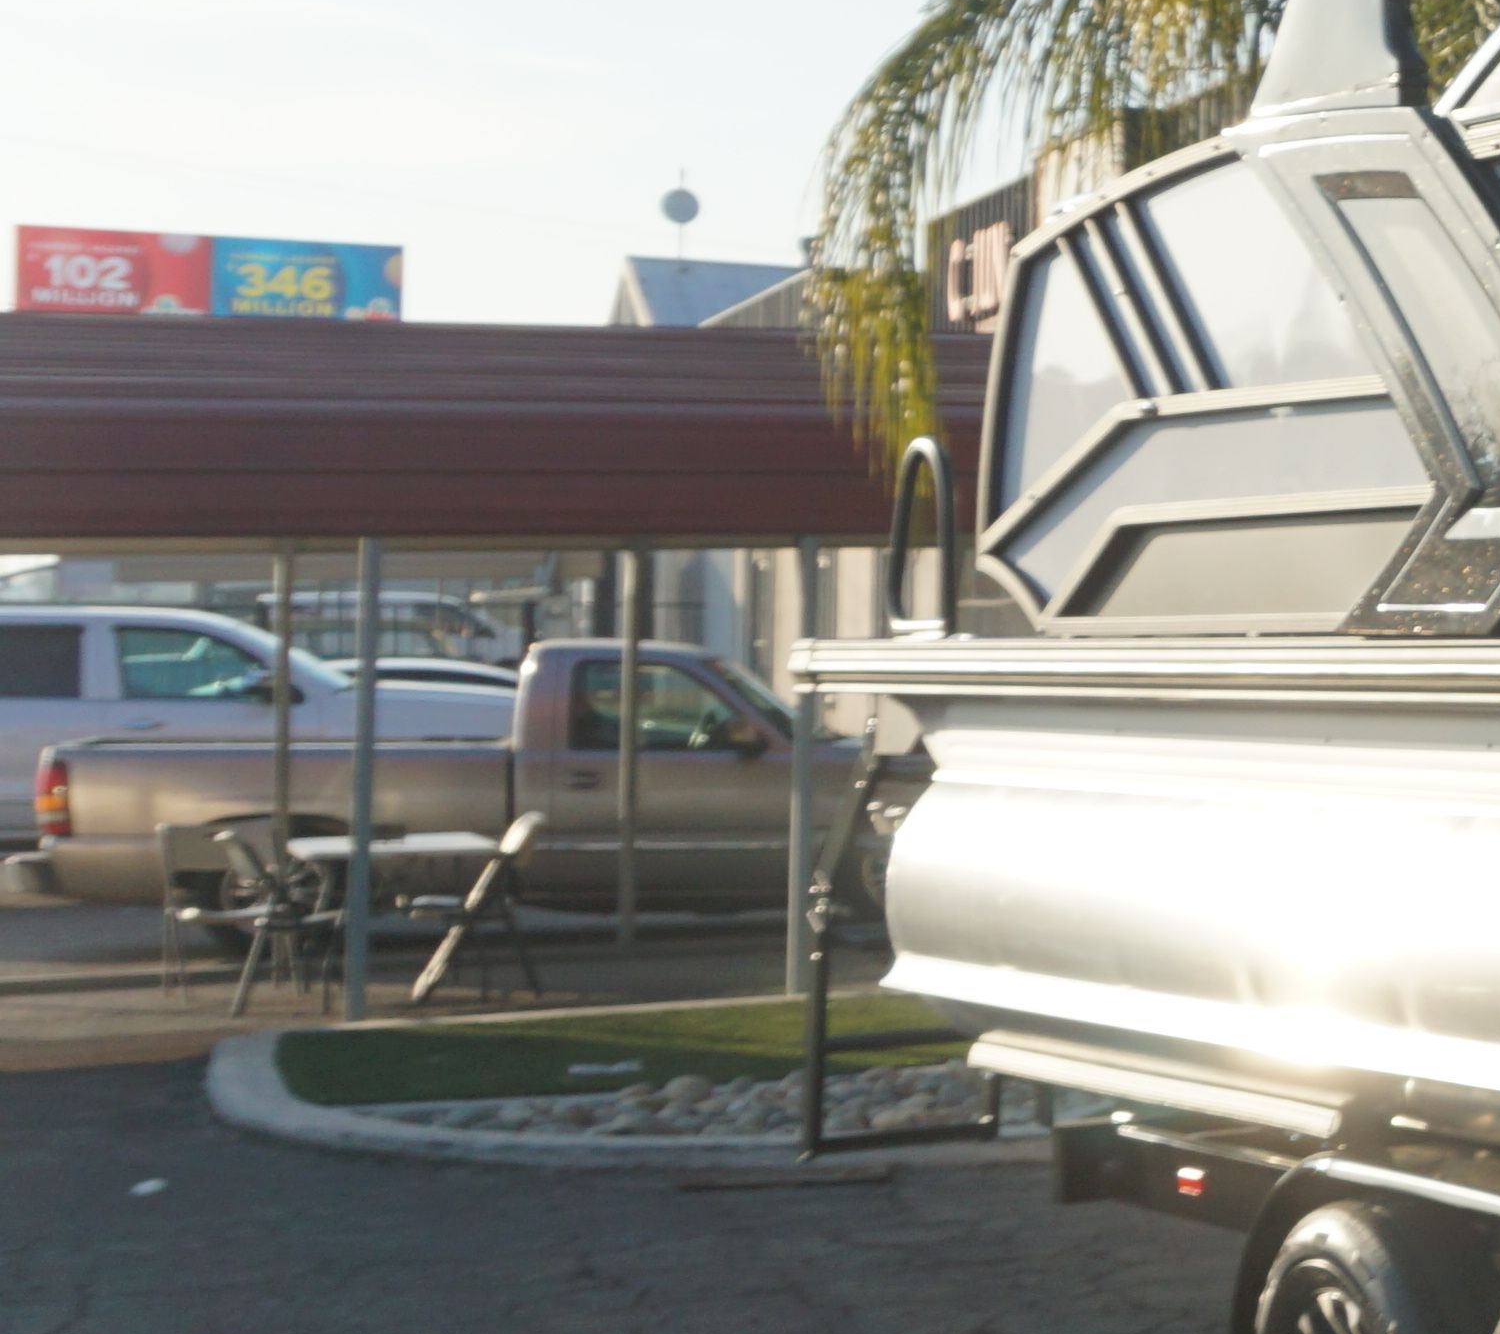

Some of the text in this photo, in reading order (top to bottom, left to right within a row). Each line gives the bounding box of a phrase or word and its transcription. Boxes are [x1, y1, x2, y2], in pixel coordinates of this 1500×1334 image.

[43, 254, 134, 291] 102
[236, 264, 335, 301] 346
[30, 288, 141, 308] MILLION
